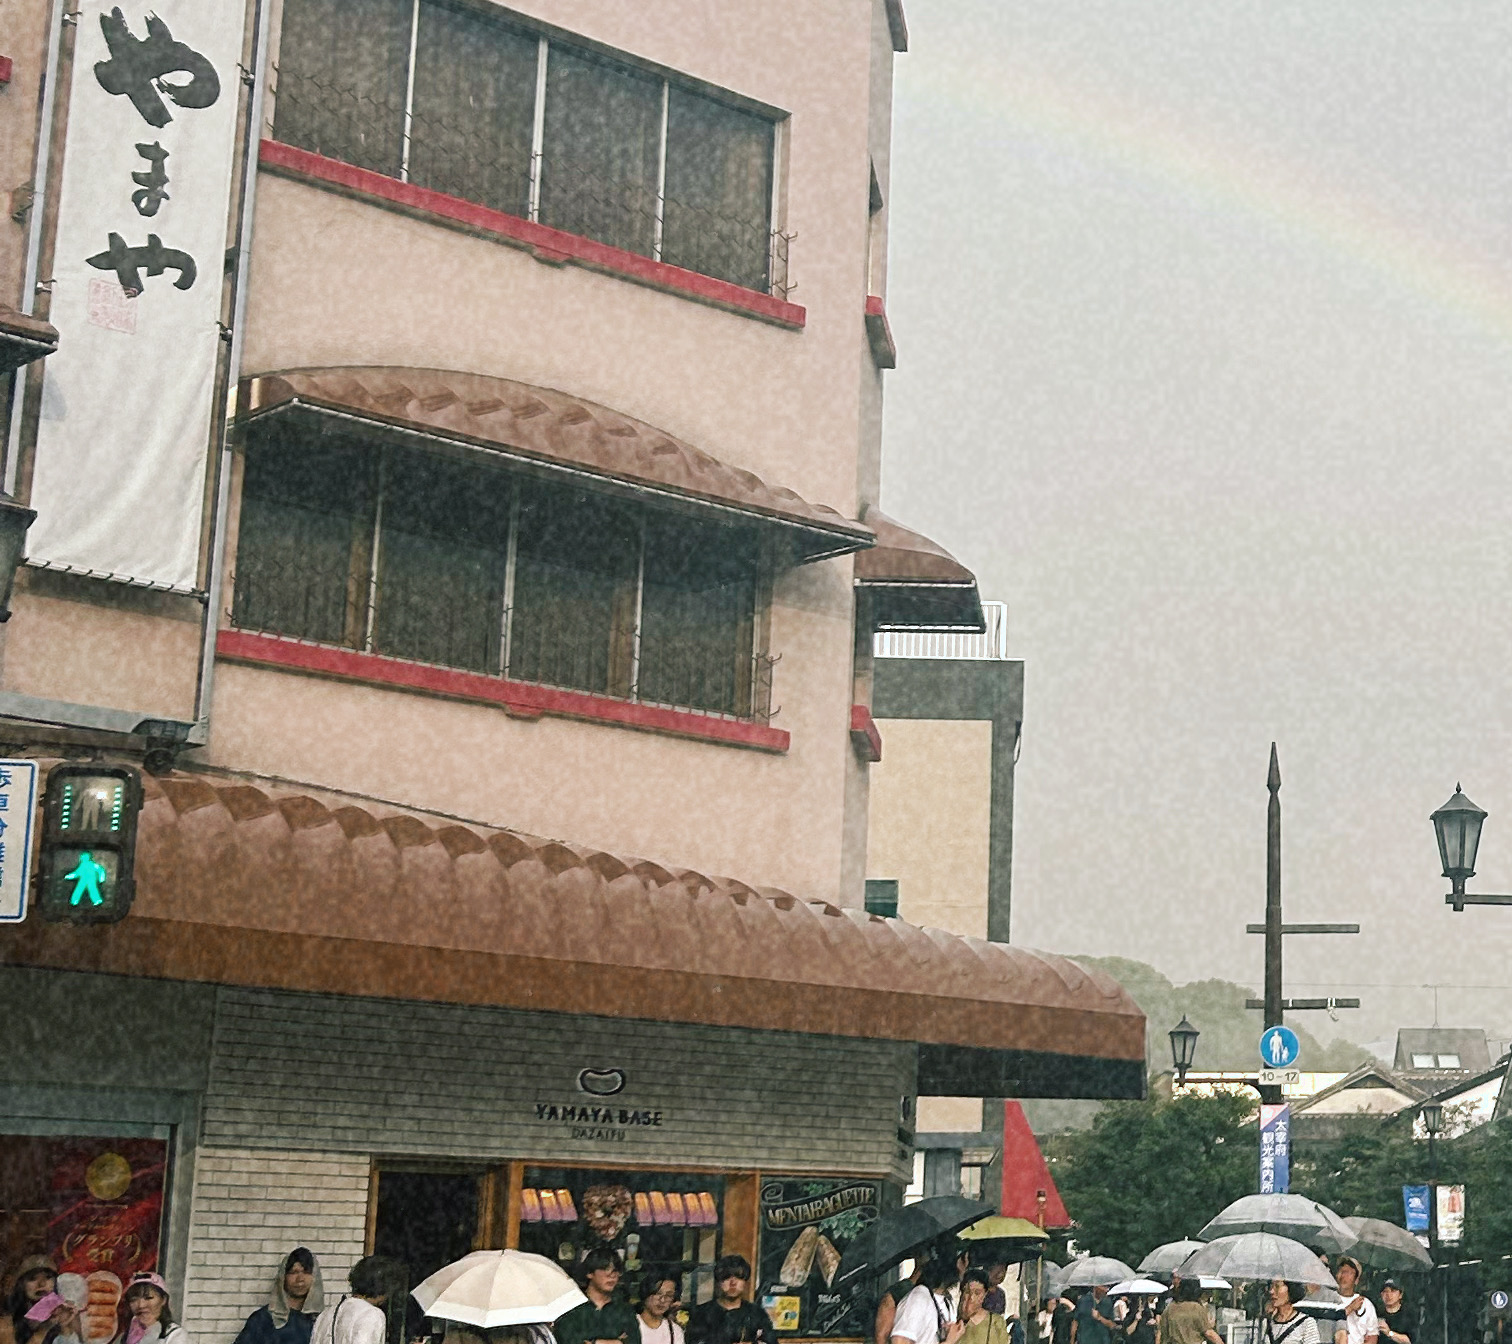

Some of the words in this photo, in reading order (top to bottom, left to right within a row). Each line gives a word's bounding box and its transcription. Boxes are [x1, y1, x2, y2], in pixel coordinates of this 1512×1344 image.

[85, 5, 221, 298] やまや
[535, 1103, 614, 1124] YAMAYA
[618, 1109, 663, 1126] BASE
[571, 1127, 626, 1142] DAZAIFU
